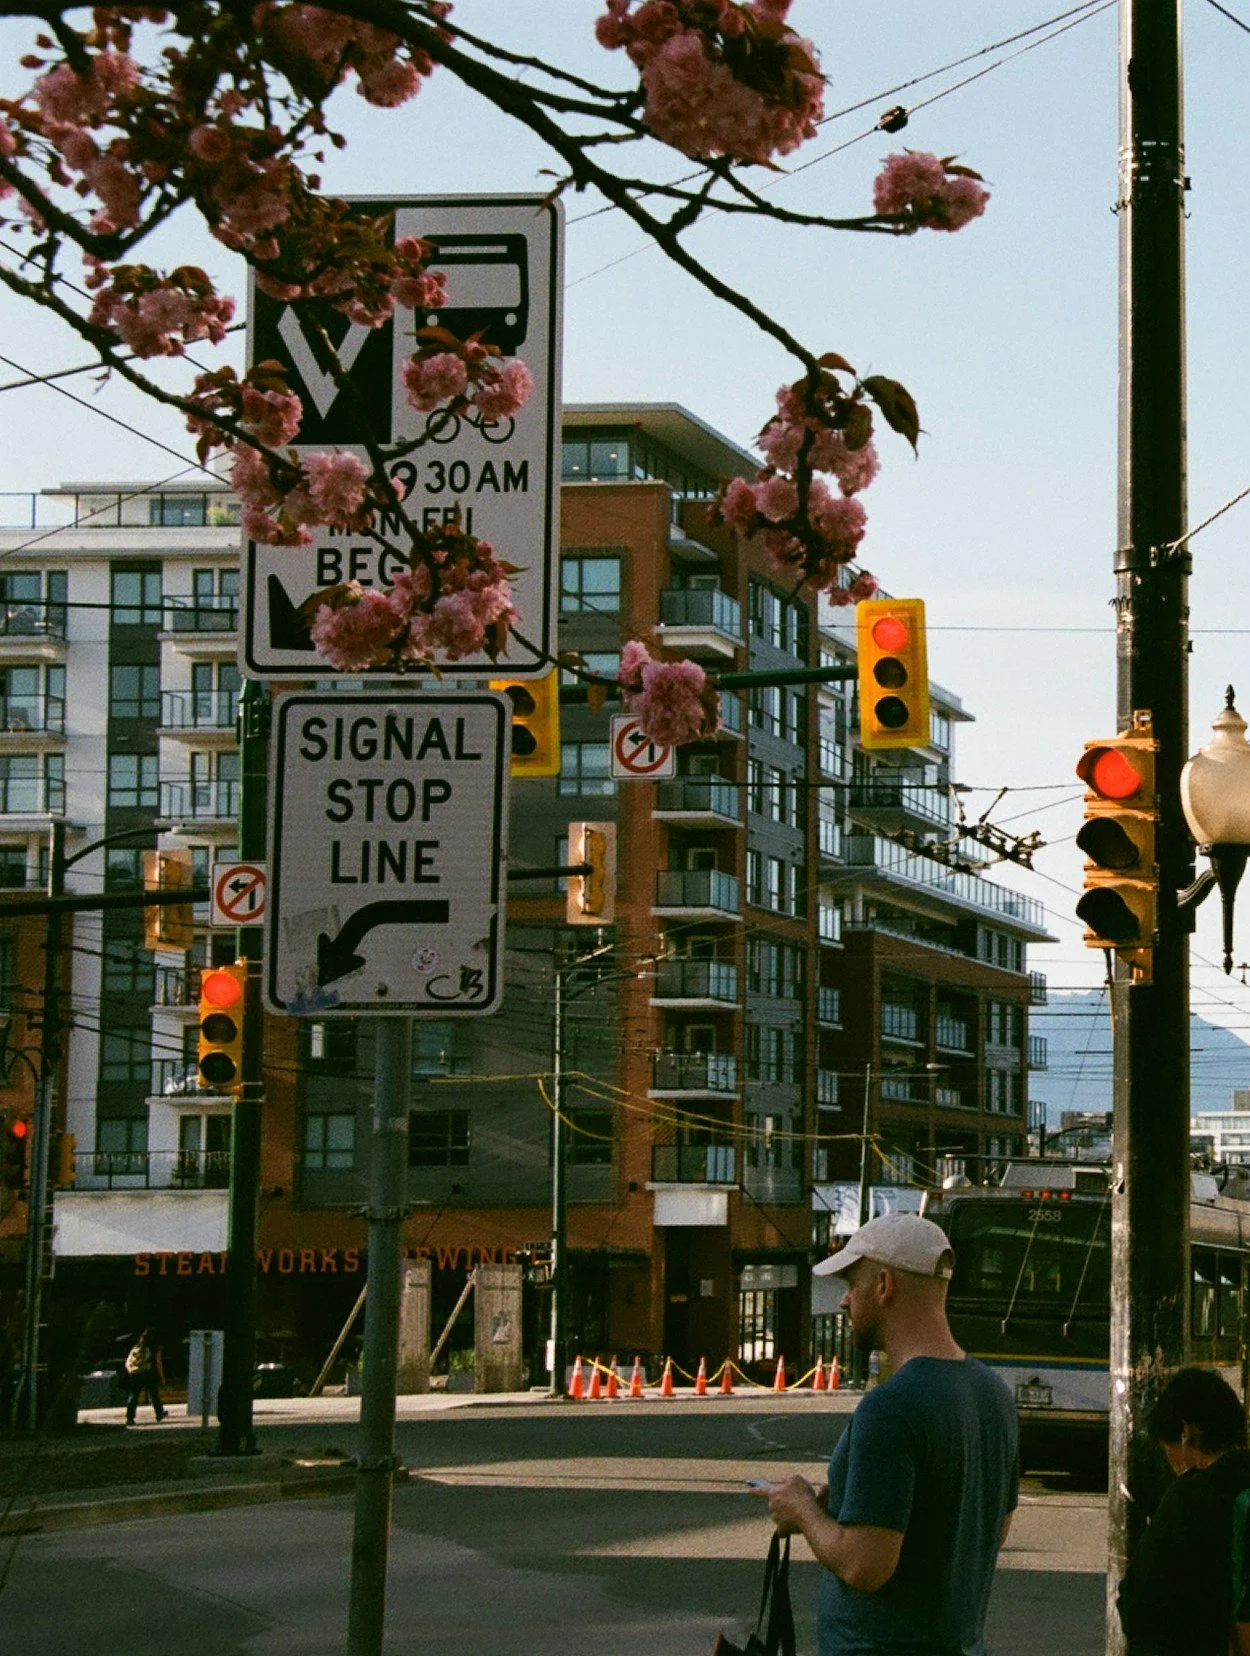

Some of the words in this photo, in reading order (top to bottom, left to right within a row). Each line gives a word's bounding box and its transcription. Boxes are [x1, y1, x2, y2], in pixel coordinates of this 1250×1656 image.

[300, 716, 482, 762] SIGNAL
[325, 778, 453, 823] STOP
[330, 840, 441, 885] LINE
[134, 1248, 360, 1276] STEAWORKS
[402, 1246, 517, 1272] EWING
